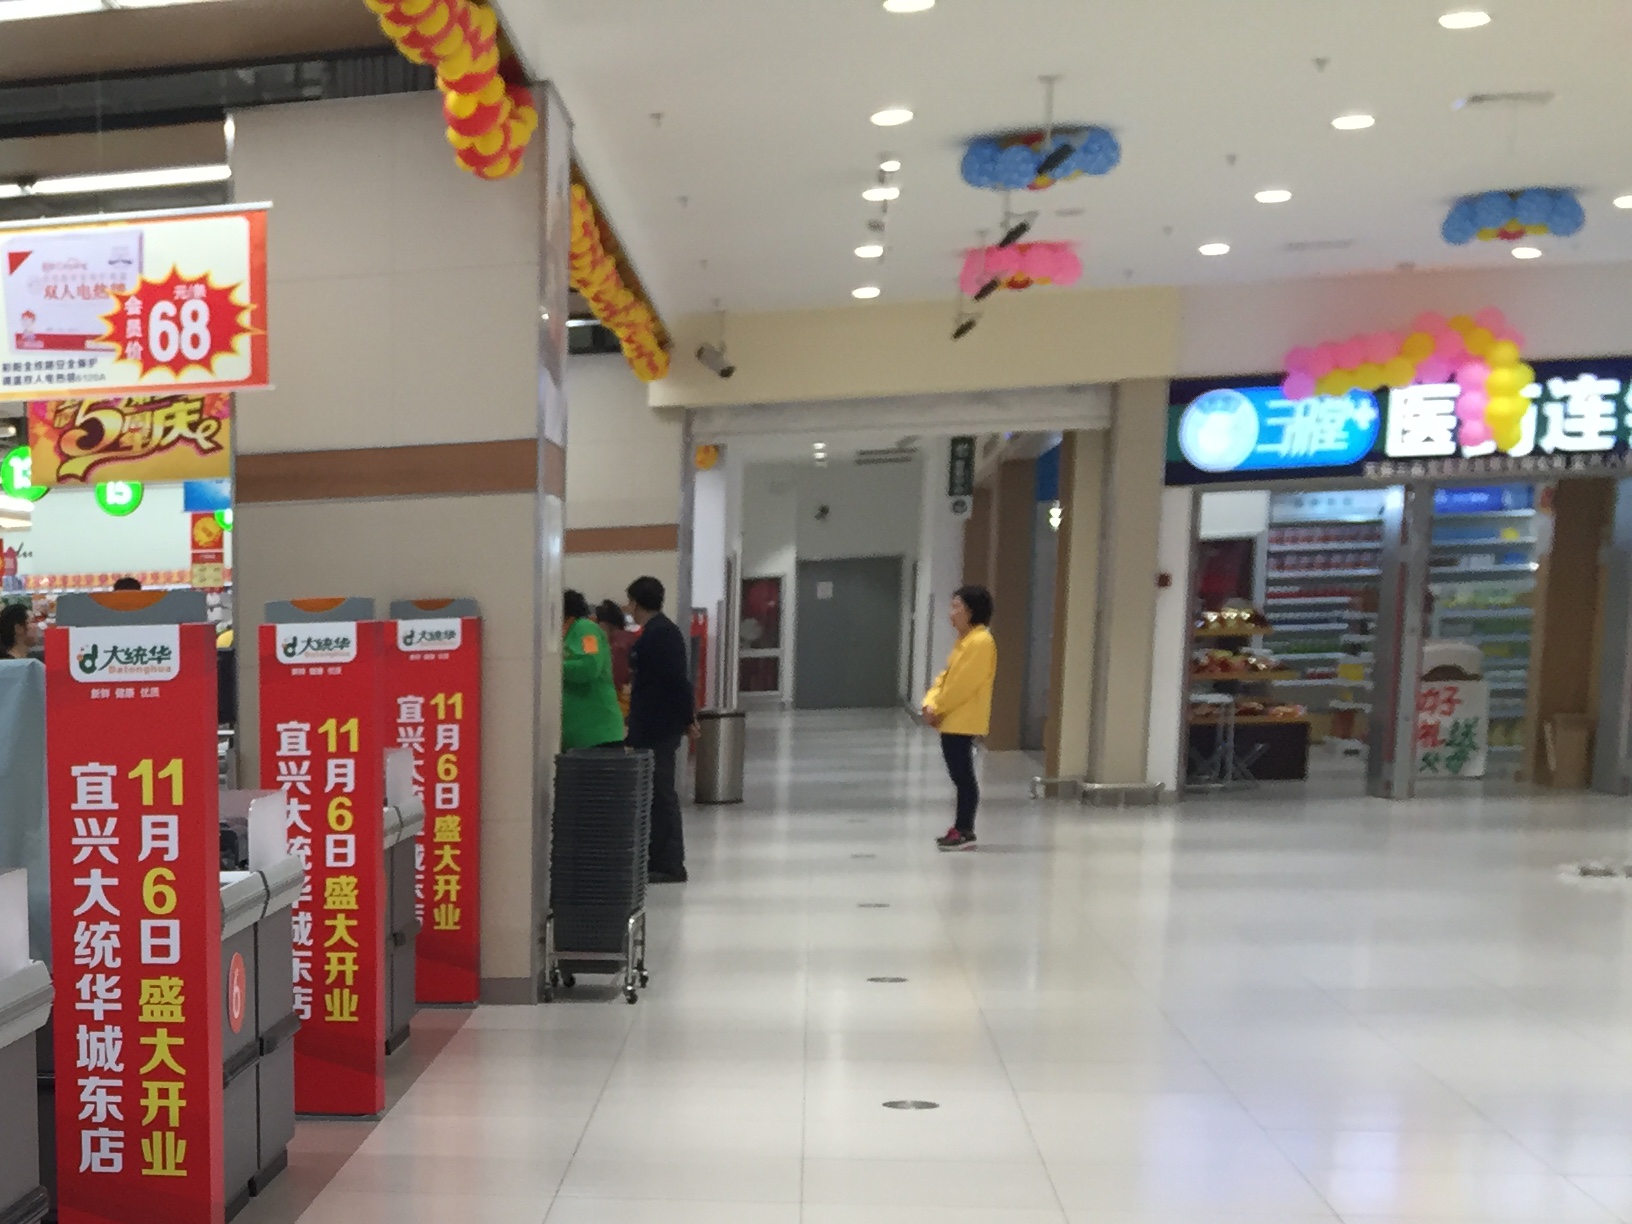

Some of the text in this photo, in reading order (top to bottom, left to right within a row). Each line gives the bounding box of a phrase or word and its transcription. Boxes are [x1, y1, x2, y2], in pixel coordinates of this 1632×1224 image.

[148, 300, 211, 362] 68
[1385, 374, 1621, 459] 医连
[98, 645, 172, 671] 大统华
[70, 762, 124, 1174] 宜兴大统华城东店
[231, 968, 242, 1013] 6
